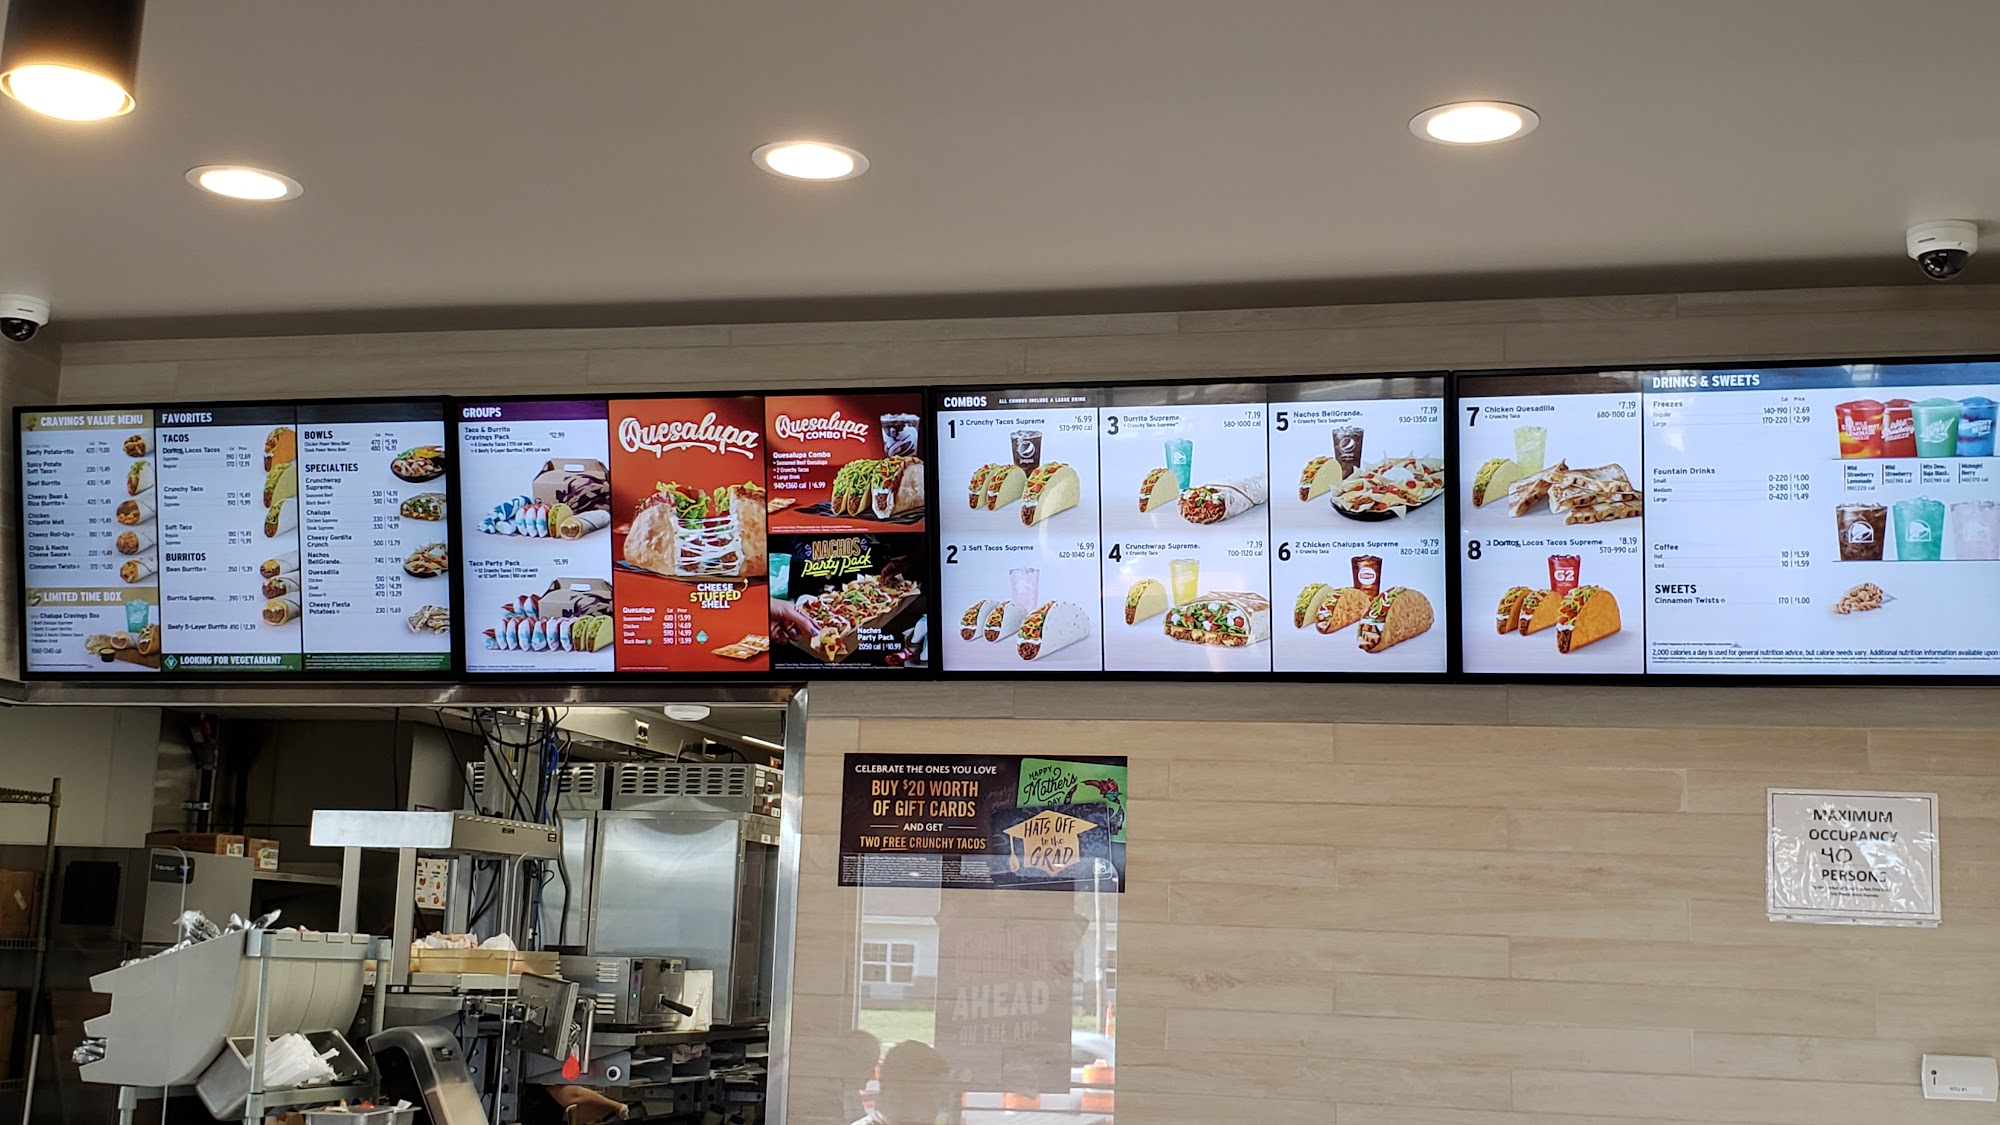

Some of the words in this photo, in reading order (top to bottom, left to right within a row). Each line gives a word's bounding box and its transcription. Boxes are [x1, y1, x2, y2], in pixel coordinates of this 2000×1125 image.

[1652, 376, 1697, 388] DRINKS
[1700, 376, 1709, 387] &
[1712, 374, 1760, 386] SWEETS
[944, 396, 987, 408] COMBOS
[1618, 401, 1636, 410] $7.19
[1653, 400, 1683, 408] Freezes
[463, 407, 502, 418] GROUPS
[1245, 411, 1261, 419] $7.19
[1421, 407, 1437, 415] $7.19
[1794, 406, 1810, 414] $2.69
[41, 416, 85, 426] CRAVINGS
[87, 416, 116, 425] VALUE
[118, 415, 143, 425] MENU
[162, 413, 212, 423] FAVORITES
[1276, 412, 1289, 431] 5
[1466, 407, 1480, 426] 7
[1762, 416, 1788, 424] 170-220
[1794, 416, 1810, 424] $2.99
[775, 411, 869, 443] Quesalupa
[966, 419, 993, 427] Crunchy
[1016, 418, 1045, 426] Supreme
[1107, 416, 1119, 435] 3
[948, 419, 956, 439] 1
[163, 434, 189, 442] TACOS
[304, 431, 333, 439] BOWLS
[618, 412, 759, 460] Quesalupa
[805, 432, 840, 440] COMBO
[306, 463, 358, 472] SPECIALTIES
[1768, 474, 1788, 482] 0-220
[1332, 541, 1365, 549] Chalupas
[1367, 541, 1398, 549] Supreme
[1420, 539, 1439, 547] $9.79
[1570, 539, 1603, 547] Supreme
[1619, 537, 1637, 545] $8.19
[811, 538, 861, 560] NACHOS
[1005, 544, 1034, 552] Supreme
[1125, 543, 1166, 551] Crunchwrap
[1278, 542, 1291, 561] 6
[1468, 540, 1481, 560] 8
[166, 553, 206, 561] BURRITOS
[946, 545, 958, 564] 2
[1108, 544, 1121, 562] 4
[801, 557, 840, 577] Party
[840, 549, 872, 573] Pack
[1554, 570, 1574, 582] G2
[697, 583, 733, 592] CHEESE
[1655, 585, 1697, 594] SWEETS
[44, 592, 78, 601] LIMITED
[80, 592, 99, 601] TIME
[101, 592, 122, 601] BOX
[689, 591, 741, 602] STUFFED
[1695, 596, 1719, 604] Twists
[701, 600, 730, 609] SHELL
[858, 634, 876, 642] Party
[180, 656, 212, 664] LOOKING
[214, 656, 228, 664] FOR
[230, 656, 281, 665] VEGETARIAN?
[855, 765, 904, 774] CELEBRATE
[906, 765, 923, 773] THE
[925, 765, 950, 774] ONES
[952, 766, 971, 774] YOU
[973, 766, 997, 774] LOVE
[1029, 766, 1052, 780] HAPPY
[872, 780, 898, 797] BUY
[903, 779, 925, 797] $20
[929, 781, 978, 797] WORTH
[1023, 768, 1078, 804] Mother's
[1047, 797, 1064, 806] DAY
[873, 800, 890, 817] OF
[895, 801, 925, 817] GIFT
[931, 801, 976, 817] CARDS
[1813, 810, 1892, 822] MAXIMUM
[925, 824, 943, 832] GET
[1024, 818, 1050, 837] HATS
[1055, 817, 1076, 834] OFF
[1809, 829, 1898, 842] OCCUPANCY
[860, 836, 880, 848] TWO
[883, 836, 906, 849] FREE
[909, 837, 954, 849] CRUNCHY
[956, 837, 986, 849] TACOS
[1030, 846, 1073, 871] GRAD
[1821, 848, 1852, 863] 40
[1822, 870, 1886, 882] PERSONS
[952, 981, 1049, 1021] AHEAD
